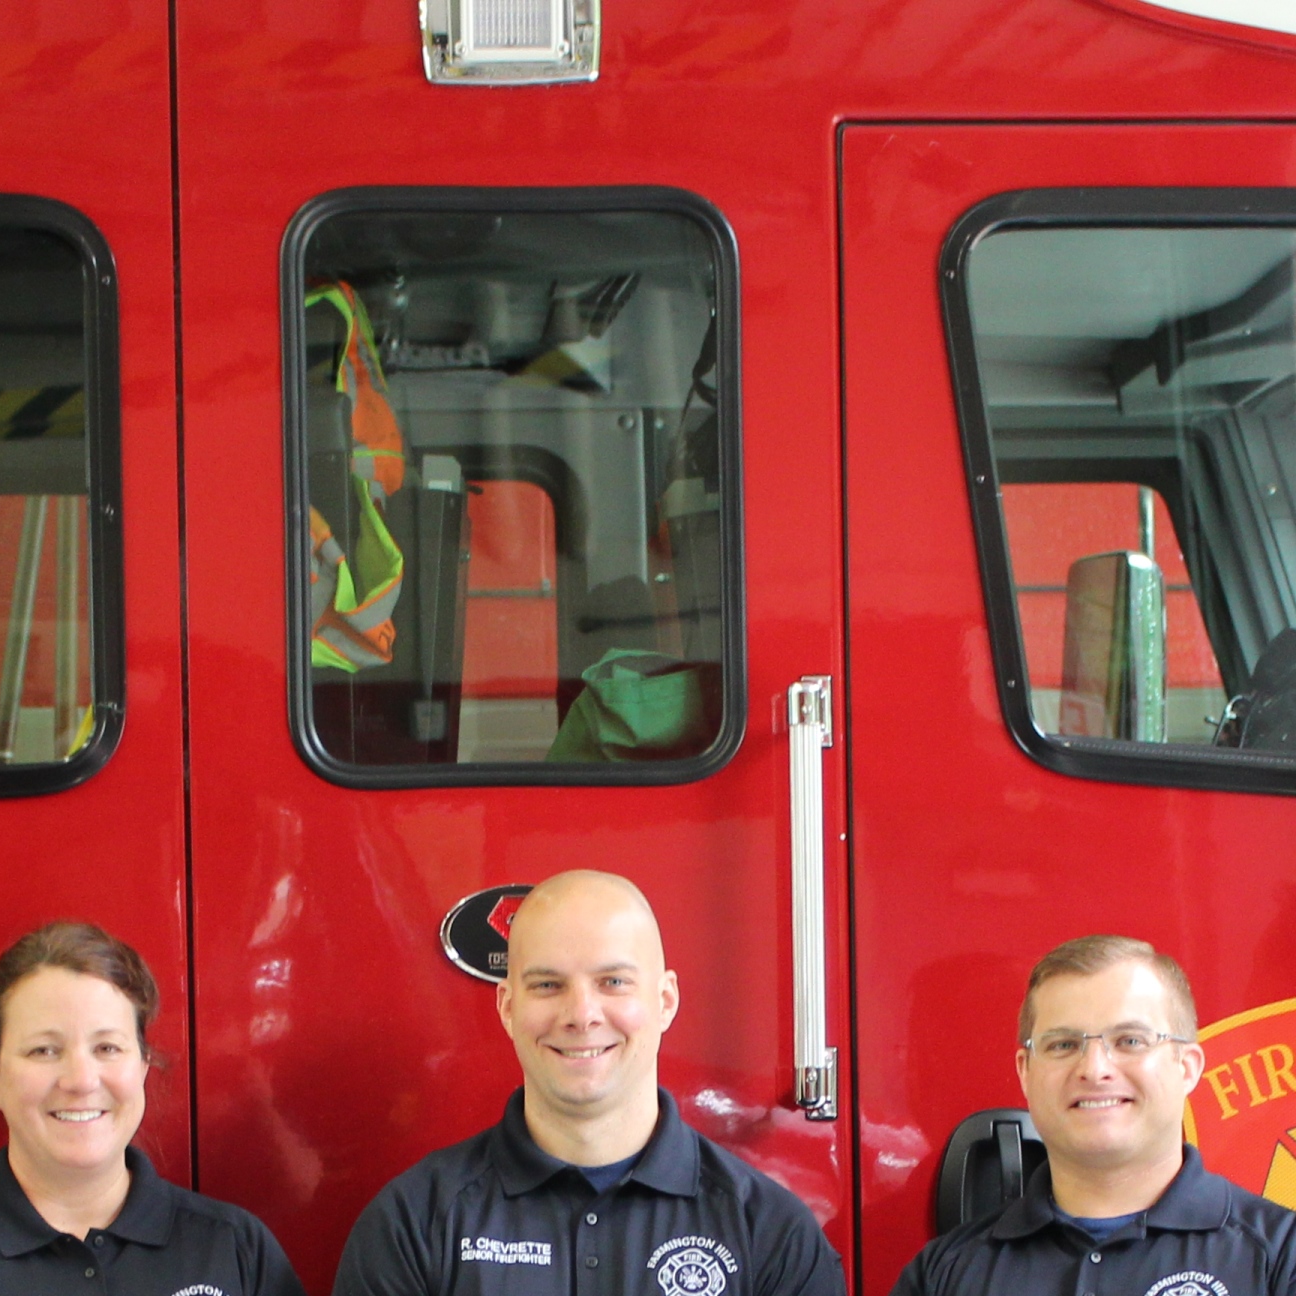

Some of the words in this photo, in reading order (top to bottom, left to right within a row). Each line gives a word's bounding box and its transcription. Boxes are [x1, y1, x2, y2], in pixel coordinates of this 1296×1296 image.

[476, 1237, 552, 1255] CHEVRETTE
[647, 1235, 716, 1269] FARMINGTON
[714, 1244, 739, 1274] HILLS
[461, 1250, 493, 1261] SENIOR
[495, 1253, 551, 1266] FIREFIGHTER
